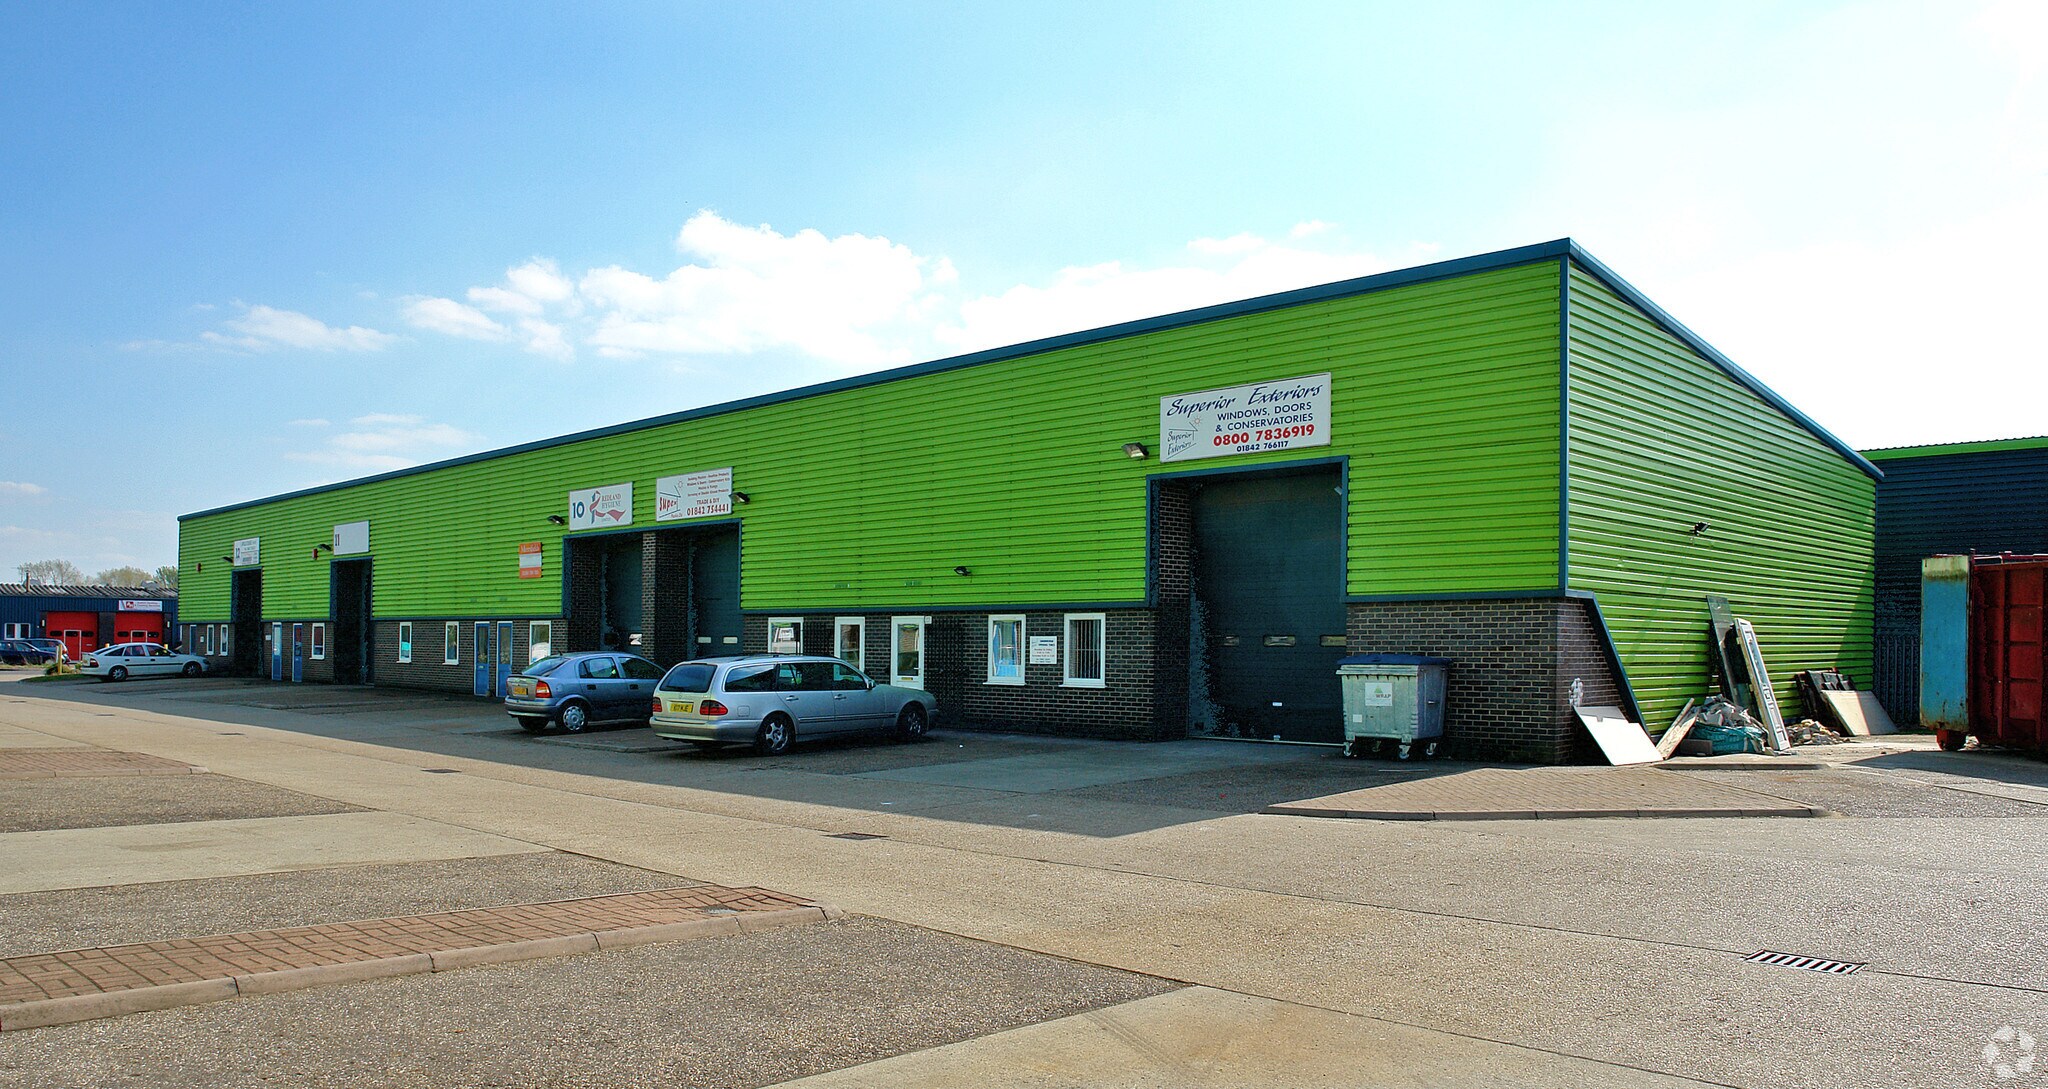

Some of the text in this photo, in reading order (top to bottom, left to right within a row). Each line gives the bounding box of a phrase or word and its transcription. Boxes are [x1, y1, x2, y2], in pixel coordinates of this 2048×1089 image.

[1166, 384, 1323, 418] Superior Exteriors
[1217, 401, 1312, 421] WINDOWS, DOORS
[1215, 413, 1313, 433] & CONSERVATORIES
[1167, 430, 1192, 443] Superior
[1213, 424, 1315, 447] 0800 7836919
[1236, 440, 1289, 452] 01842 766117
[572, 501, 585, 519] 10
[686, 506, 705, 516] 01842
[707, 503, 729, 514] 754441
[335, 534, 340, 547] 11
[236, 547, 240, 559] 12
